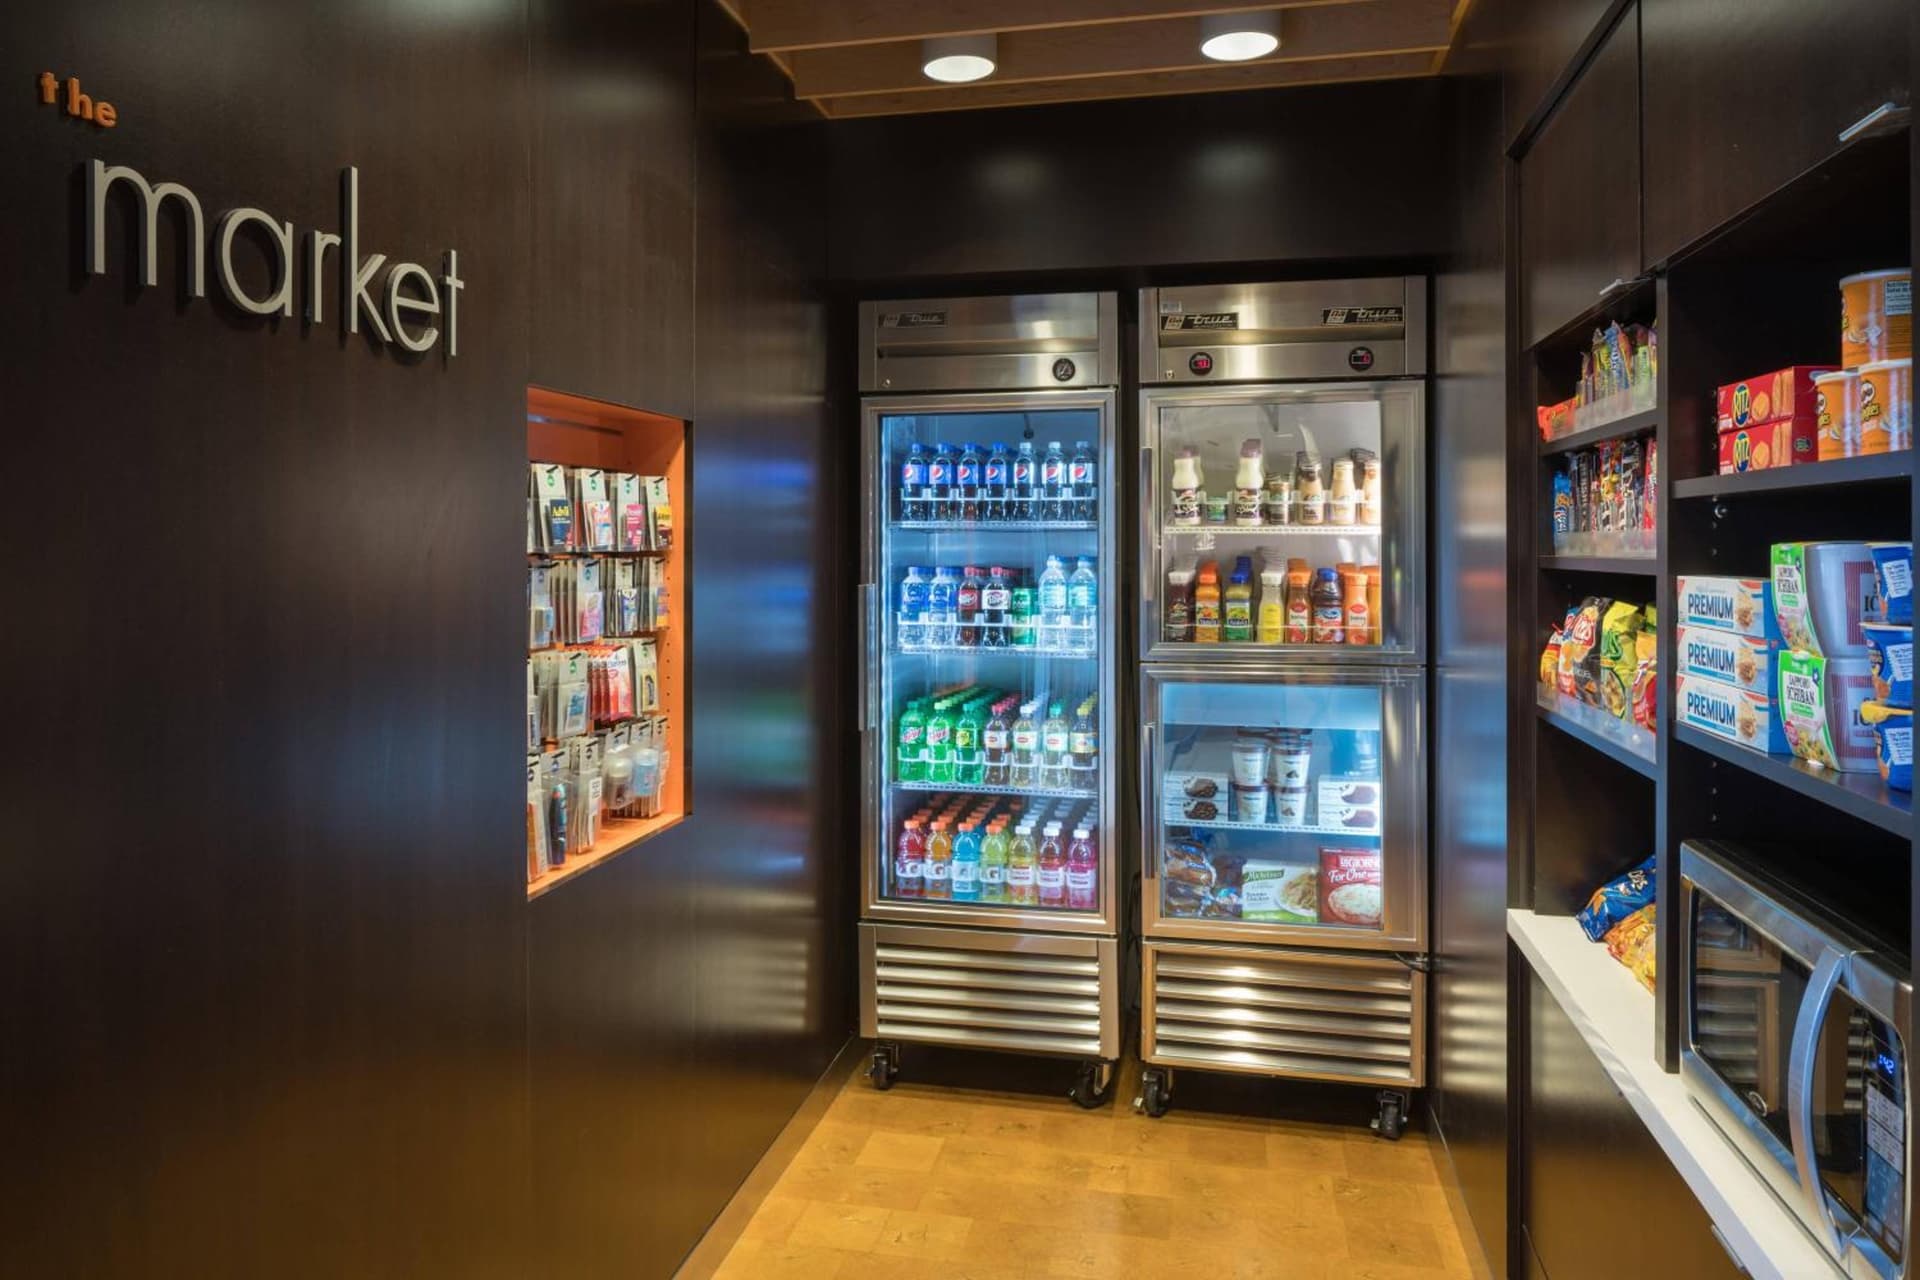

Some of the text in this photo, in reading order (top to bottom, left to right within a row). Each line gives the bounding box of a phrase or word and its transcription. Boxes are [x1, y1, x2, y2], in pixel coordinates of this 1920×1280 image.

[40, 71, 117, 127] the
[86, 158, 464, 356] market
[1688, 593, 1734, 620] PREMIUM
[1688, 643, 1735, 673] PREMIUM
[1688, 692, 1736, 727] PREMIUM
[1328, 869, 1345, 883] For
